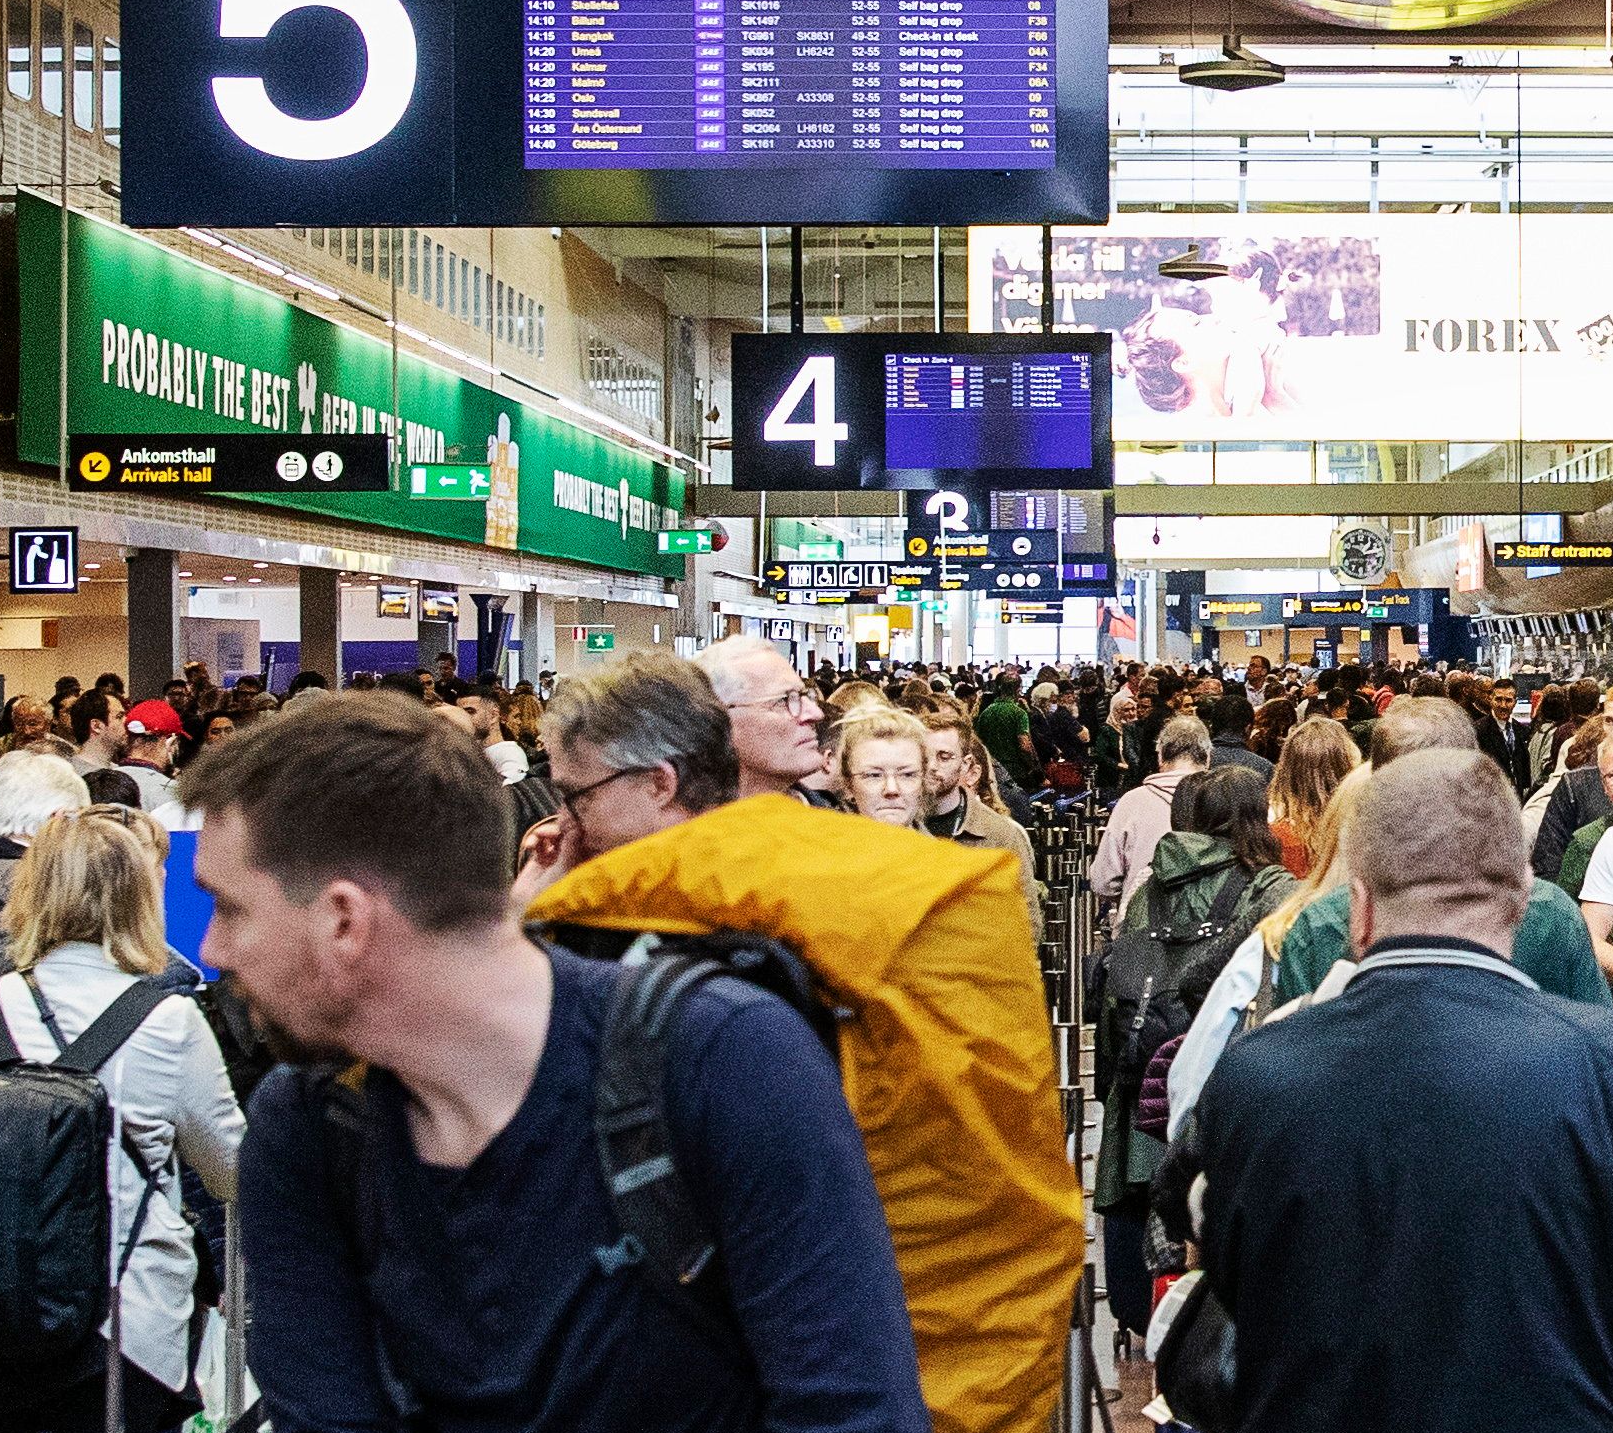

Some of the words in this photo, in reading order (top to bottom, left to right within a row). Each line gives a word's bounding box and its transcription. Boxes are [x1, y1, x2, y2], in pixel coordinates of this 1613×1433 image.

[528, 32, 555, 41] 14:15
[572, 32, 614, 43] Bangkok
[852, 32, 880, 41] 49-52
[899, 32, 941, 41] Check-in
[943, 32, 953, 41] at
[955, 32, 978, 41] desk
[1092, 245, 1125, 271] till
[1054, 282, 1111, 300] mer
[1403, 318, 1561, 353] FOREX
[101, 318, 208, 411] PROBABLY
[211, 356, 245, 418] THE
[250, 367, 292, 433] BEST
[406, 415, 446, 466] WORLD
[763, 355, 849, 467] 4
[120, 445, 217, 465] Ankomsthall
[120, 465, 178, 485] Arrivals
[182, 465, 212, 484] hall
[554, 469, 590, 515] PROBABLY
[1516, 542, 1549, 559] Staff
[1551, 545, 1613, 559] entrance
